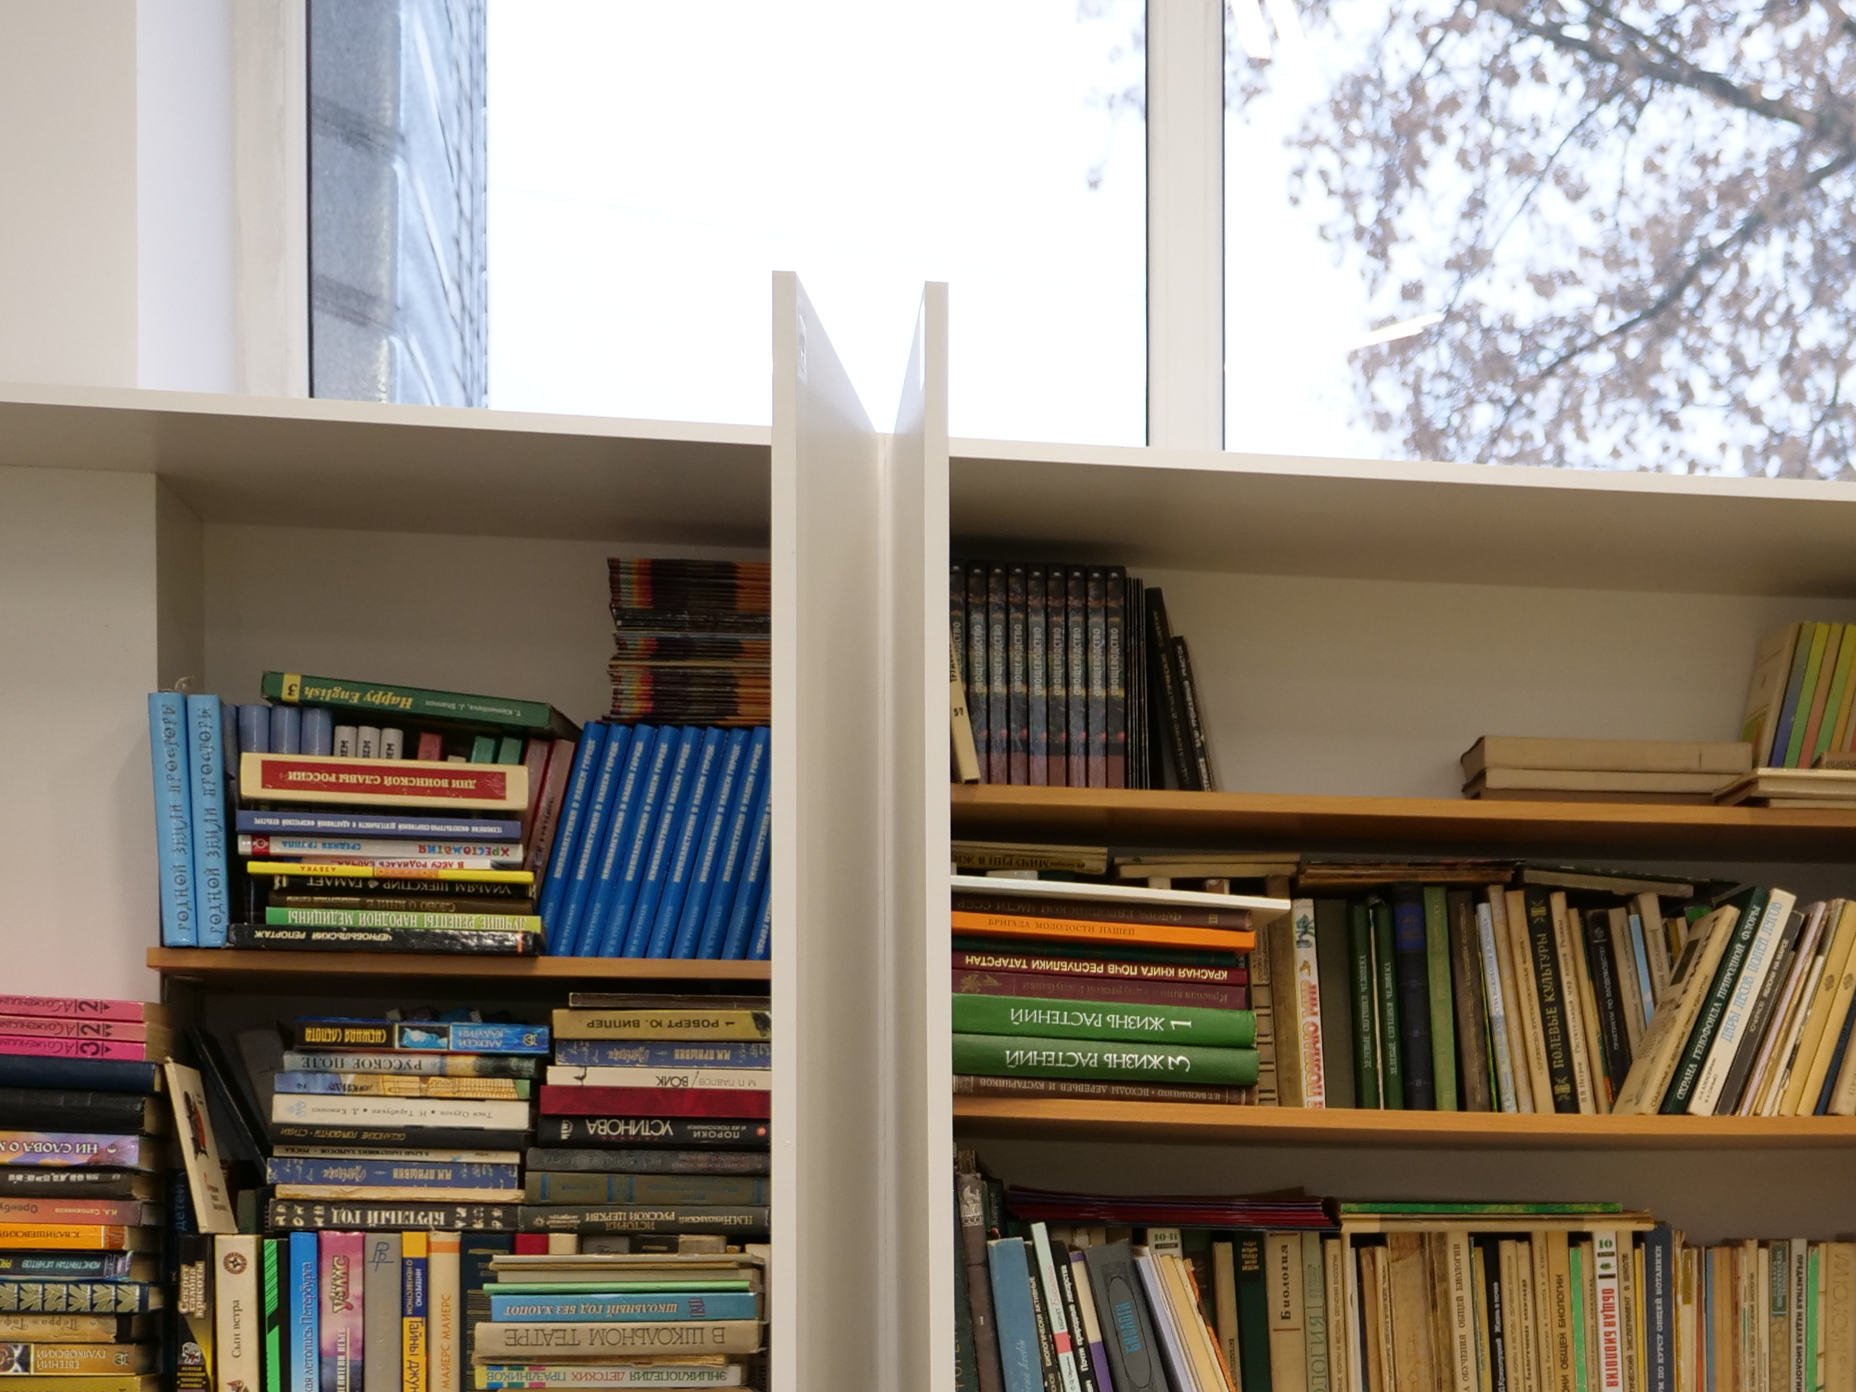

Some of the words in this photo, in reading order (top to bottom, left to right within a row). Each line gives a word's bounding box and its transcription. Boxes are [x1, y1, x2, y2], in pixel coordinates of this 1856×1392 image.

[1033, 627, 1042, 696] ОВОЩЕВОДСТВО
[1053, 627, 1062, 696] ОВОЩЕВОДСТВО
[288, 684, 297, 696] 3
[303, 686, 361, 703] English
[363, 690, 413, 709] Happy
[287, 771, 336, 783] РОССИИ
[339, 774, 381, 784] СЛАВЫ
[384, 776, 450, 789] ВОИНСКОЙ
[452, 779, 476, 790] ДНИ
[281, 840, 317, 850] ГРУППА
[321, 842, 361, 851] СРЕДНЯЯ
[419, 845, 509, 856] ХРЕСТОМАТИЯ
[300, 865, 336, 873] АЗБУКА
[307, 876, 362, 887] ГАМЛЕТ
[383, 880, 449, 890] ШЕКСПИР
[455, 883, 511, 894] УИЛЬЯМ
[287, 910, 354, 925] МЕДИЦИНЫ
[359, 912, 417, 927] НАРОДНОЙ
[423, 914, 475, 928] РЕЦЕПТЫ
[478, 916, 527, 929] ЛУЧШИЕ
[254, 930, 306, 940] РЕПОРТАЖ
[311, 930, 392, 942] ЧЕРНОБЫЛЬСКИЙ
[966, 956, 1027, 969] ТАТАРСТАН
[1031, 960, 1104, 973] РЕСПУБЛИКИ
[1536, 933, 1555, 1002] КУЛЬТУРЫ
[1107, 964, 1138, 975] ПОЧВ
[1140, 966, 1175, 977] КНИГА
[1178, 968, 1228, 980] КРАСНАЯ
[1720, 1012, 1741, 1043] ДАРЫ
[1734, 976, 1755, 1010] ЛЕСОВ
[1762, 902, 1782, 936] ЛУГОВ
[1677, 1064, 1698, 1100] ОХРАНА
[1691, 1002, 1721, 1059] ГЕНОФОНДА
[1717, 944, 1745, 999] ПРИРОДНОЙ
[1741, 904, 1761, 940] ФЛОРЫ
[587, 1020, 639, 1028] ВИППЕР
[646, 1020, 663, 1028] Ю.
[668, 1020, 719, 1028] РОБЕРТ
[1009, 1008, 1102, 1027] РАСТЕНИЙ
[1107, 1014, 1165, 1031] ЖИЗНЬ
[1170, 1019, 1192, 1029] 1
[305, 1027, 342, 1043] СЛЕПОТА
[345, 1028, 386, 1043] СНЕЖНАЯ
[459, 1030, 503, 1038] КАЛУГИН
[1546, 1007, 1565, 1068] ПОЛЕВЫЕ
[459, 1039, 502, 1048] АЛЕКСЕЙ
[301, 1057, 344, 1068] ПОЛЕ
[352, 1058, 422, 1070] РУССКОЕ
[1005, 1049, 1098, 1069] РАСТЕНИЙ
[1103, 1053, 1165, 1070] ЖИЗНЬ
[1167, 1055, 1191, 1072] 3
[656, 1076, 689, 1087] ВОЛК
[980, 1078, 1045, 1091] КУСТАРНИКОВ
[1049, 1083, 1056, 1091] И
[1061, 1083, 1107, 1094] ДЕРЕВЬЕВ
[1110, 1086, 1149, 1097] ВСХОДЫ
[585, 1119, 674, 1136] УСТИНОВА
[693, 1130, 740, 1138] ПОРОКИ
[9, 1142, 19, 1150] О
[23, 1141, 72, 1153] СЛОВА
[75, 1143, 97, 1154] НИ
[331, 1209, 361, 1224] ГОД
[368, 1210, 445, 1226] КРУГЛЫЙ
[585, 1211, 627, 1221] ЦЕРКВИ
[628, 1211, 675, 1220] РУССКОЙ
[605, 1221, 655, 1230] ИСТОРИЯ
[1453, 1244, 1463, 1291] БИОЛОГИИ
[1655, 1245, 1663, 1295] БОТАНИКИ
[195, 1260, 206, 1317] красоты
[1280, 1245, 1292, 1320] Биология
[180, 1266, 189, 1313] Секрет
[188, 1268, 197, 1311] салона
[301, 1262, 315, 1324] Петербурга
[1556, 1275, 1566, 1328] БИОЛОГИИ
[1601, 1288, 1616, 1327] ОБЩАЯ
[504, 1305, 554, 1316] ХЛОПОТ
[556, 1305, 576, 1315] БЕЗ
[581, 1304, 602, 1315] ГОД
[607, 1303, 678, 1317] ШКОЛЬНЫЙ
[1456, 1295, 1466, 1328] ОБЩЕЙ
[1655, 1298, 1664, 1331] ОБЩЕЙ
[409, 1317, 424, 1356] Тайны
[504, 1329, 580, 1346] ТЕАТРЕ
[590, 1327, 704, 1345] ШКОЛЬНОМ
[712, 1327, 725, 1342] В
[232, 1332, 242, 1358] Сын
[302, 1327, 314, 1374] летопись
[1558, 1333, 1569, 1370] ОБЩЕЙ
[1657, 1334, 1665, 1363] КУРСУ
[36, 1349, 106, 1359] ГУЛЯКОВСКИЙ
[1459, 1334, 1469, 1381] ОБУЧЕНИЯ
[1603, 1330, 1618, 1387] БИОЛОГИЯ
[36, 1360, 80, 1369] ЕВГЕНИЙ
[440, 1345, 451, 1388] МАЙЕРС
[486, 1371, 566, 1380] ПРАЗДНИКОВ
[571, 1371, 625, 1380] ДЕТСКИХ
[630, 1371, 726, 1380] ЭНЦИКЛОПЕДИЯ
[1657, 1366, 1665, 1378] ПО
